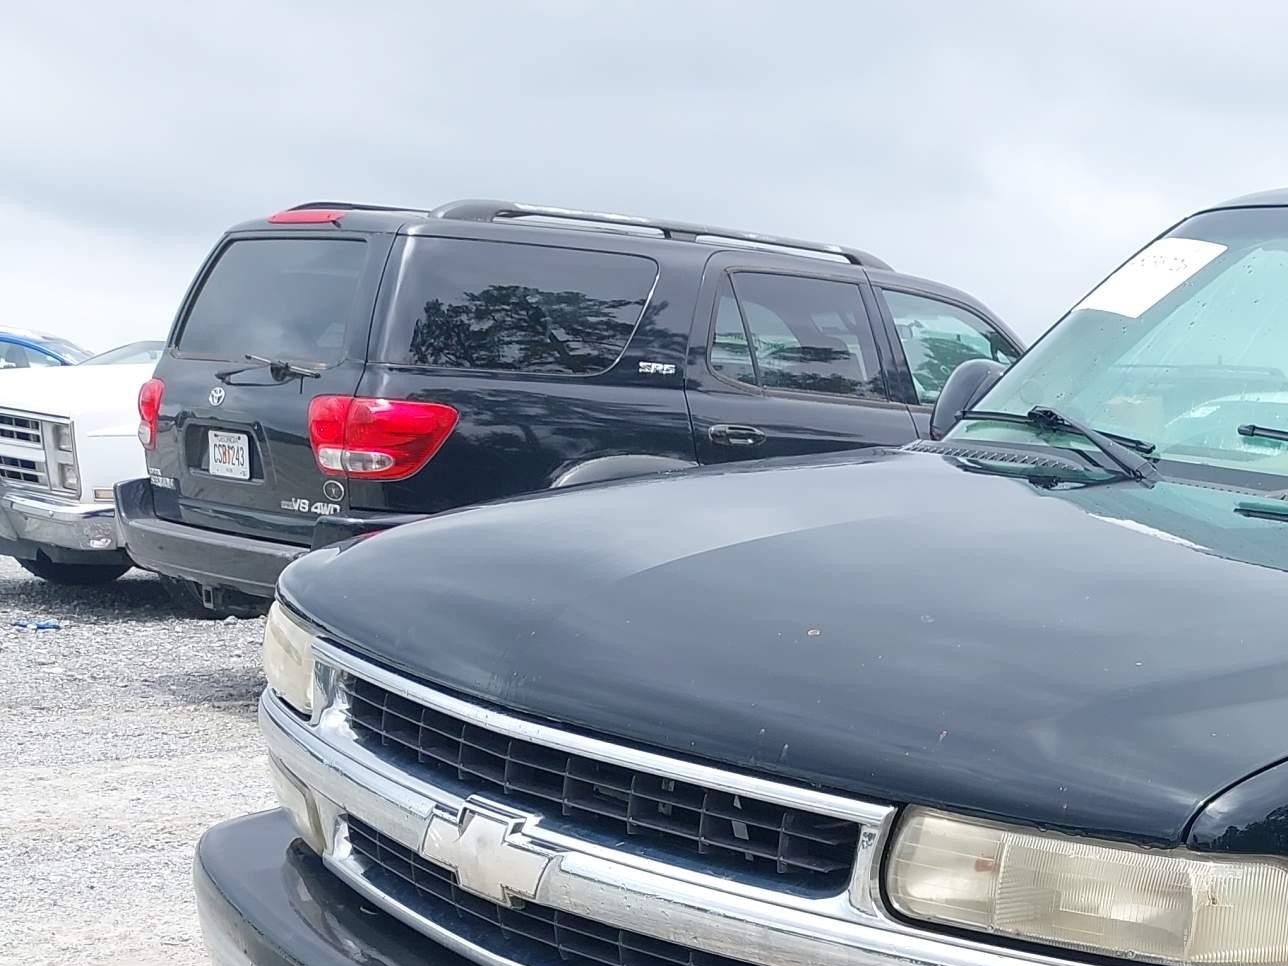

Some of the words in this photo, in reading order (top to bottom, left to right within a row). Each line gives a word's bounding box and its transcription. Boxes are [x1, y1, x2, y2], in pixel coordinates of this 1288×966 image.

[638, 361, 676, 374] SR5
[291, 497, 310, 513] V8
[310, 502, 341, 515] 4WD
